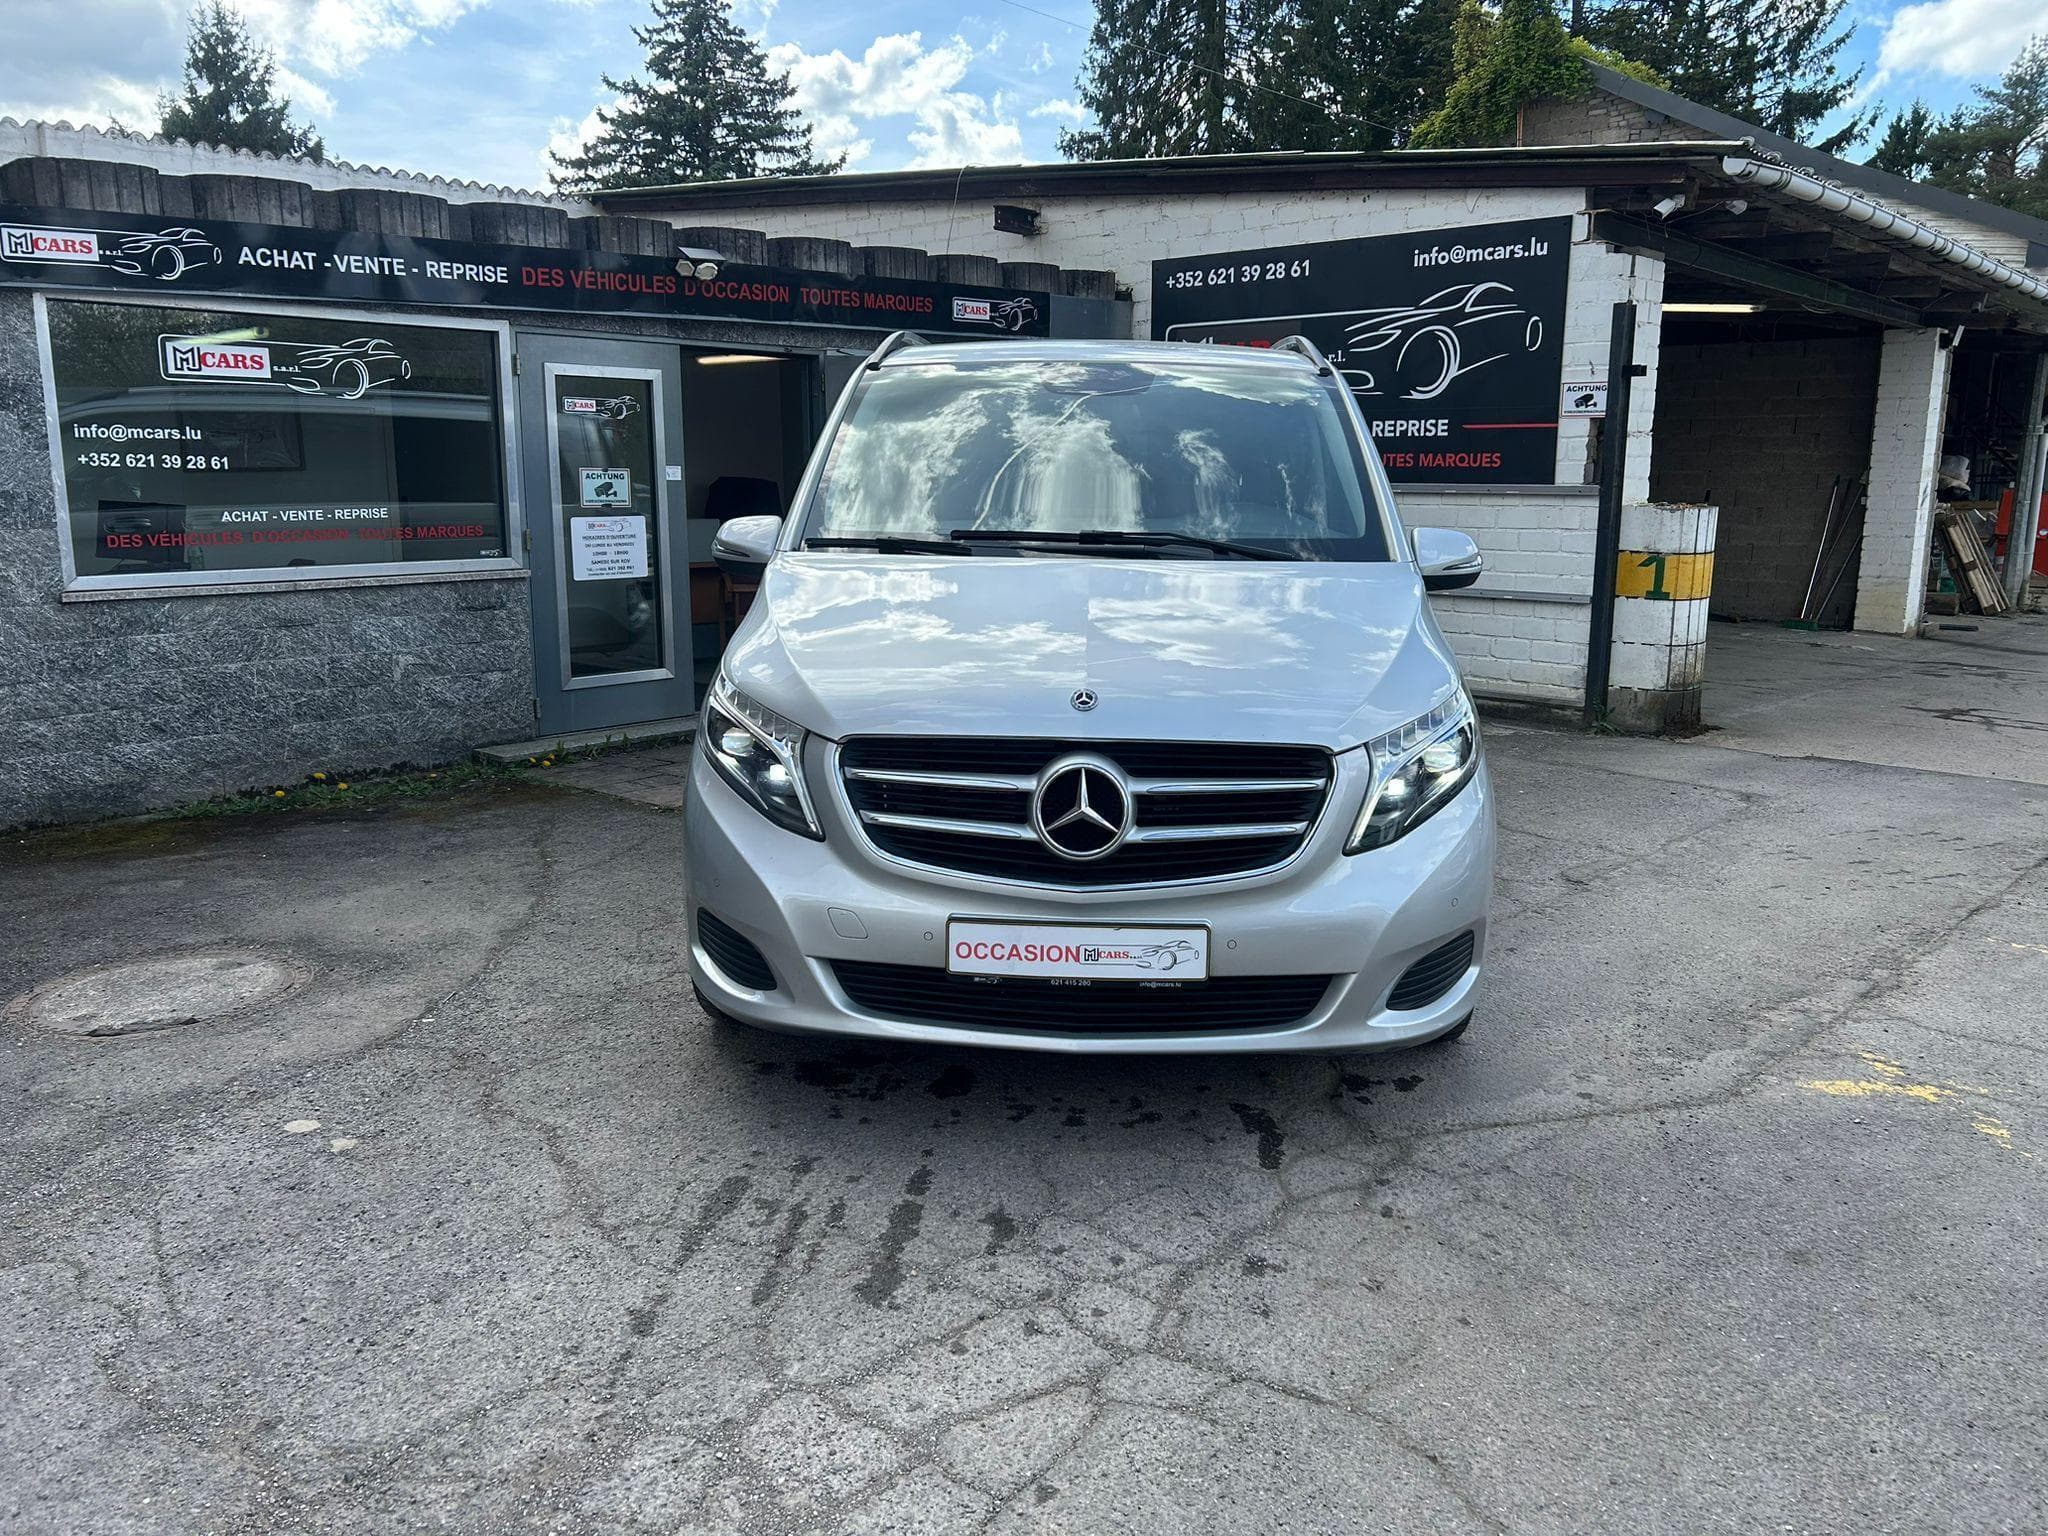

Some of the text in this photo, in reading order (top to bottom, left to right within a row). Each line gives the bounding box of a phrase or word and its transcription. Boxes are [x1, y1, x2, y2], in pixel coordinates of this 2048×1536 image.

[1413, 236, 1549, 267] info@mcars.lu
[238, 247, 316, 270] ACHAT
[333, 255, 406, 276] VENTE
[426, 261, 509, 284] REPRISE
[521, 267, 564, 288] DES
[570, 266, 676, 294] VÉHICULES
[685, 279, 789, 303] D'OCCASION
[801, 288, 860, 308] TOUTES
[864, 293, 933, 313] MARQUES
[1166, 259, 1311, 289] +352 621 39 28 61
[73, 424, 202, 442] info@mcars.lu
[1372, 419, 1449, 437] REPRISE
[77, 453, 230, 470] +352 621 39 28 61
[1419, 453, 1502, 467] MARQUES
[221, 511, 269, 522] ACHAT
[280, 510, 324, 521] VENTE
[335, 508, 389, 520] REPRISE
[106, 534, 144, 548] DES
[146, 530, 243, 547] VÉHICULES
[357, 527, 413, 541] TOUTES
[417, 525, 485, 539] MARQUES
[1637, 555, 1670, 599] 1
[955, 941, 1081, 963] OCCASION
